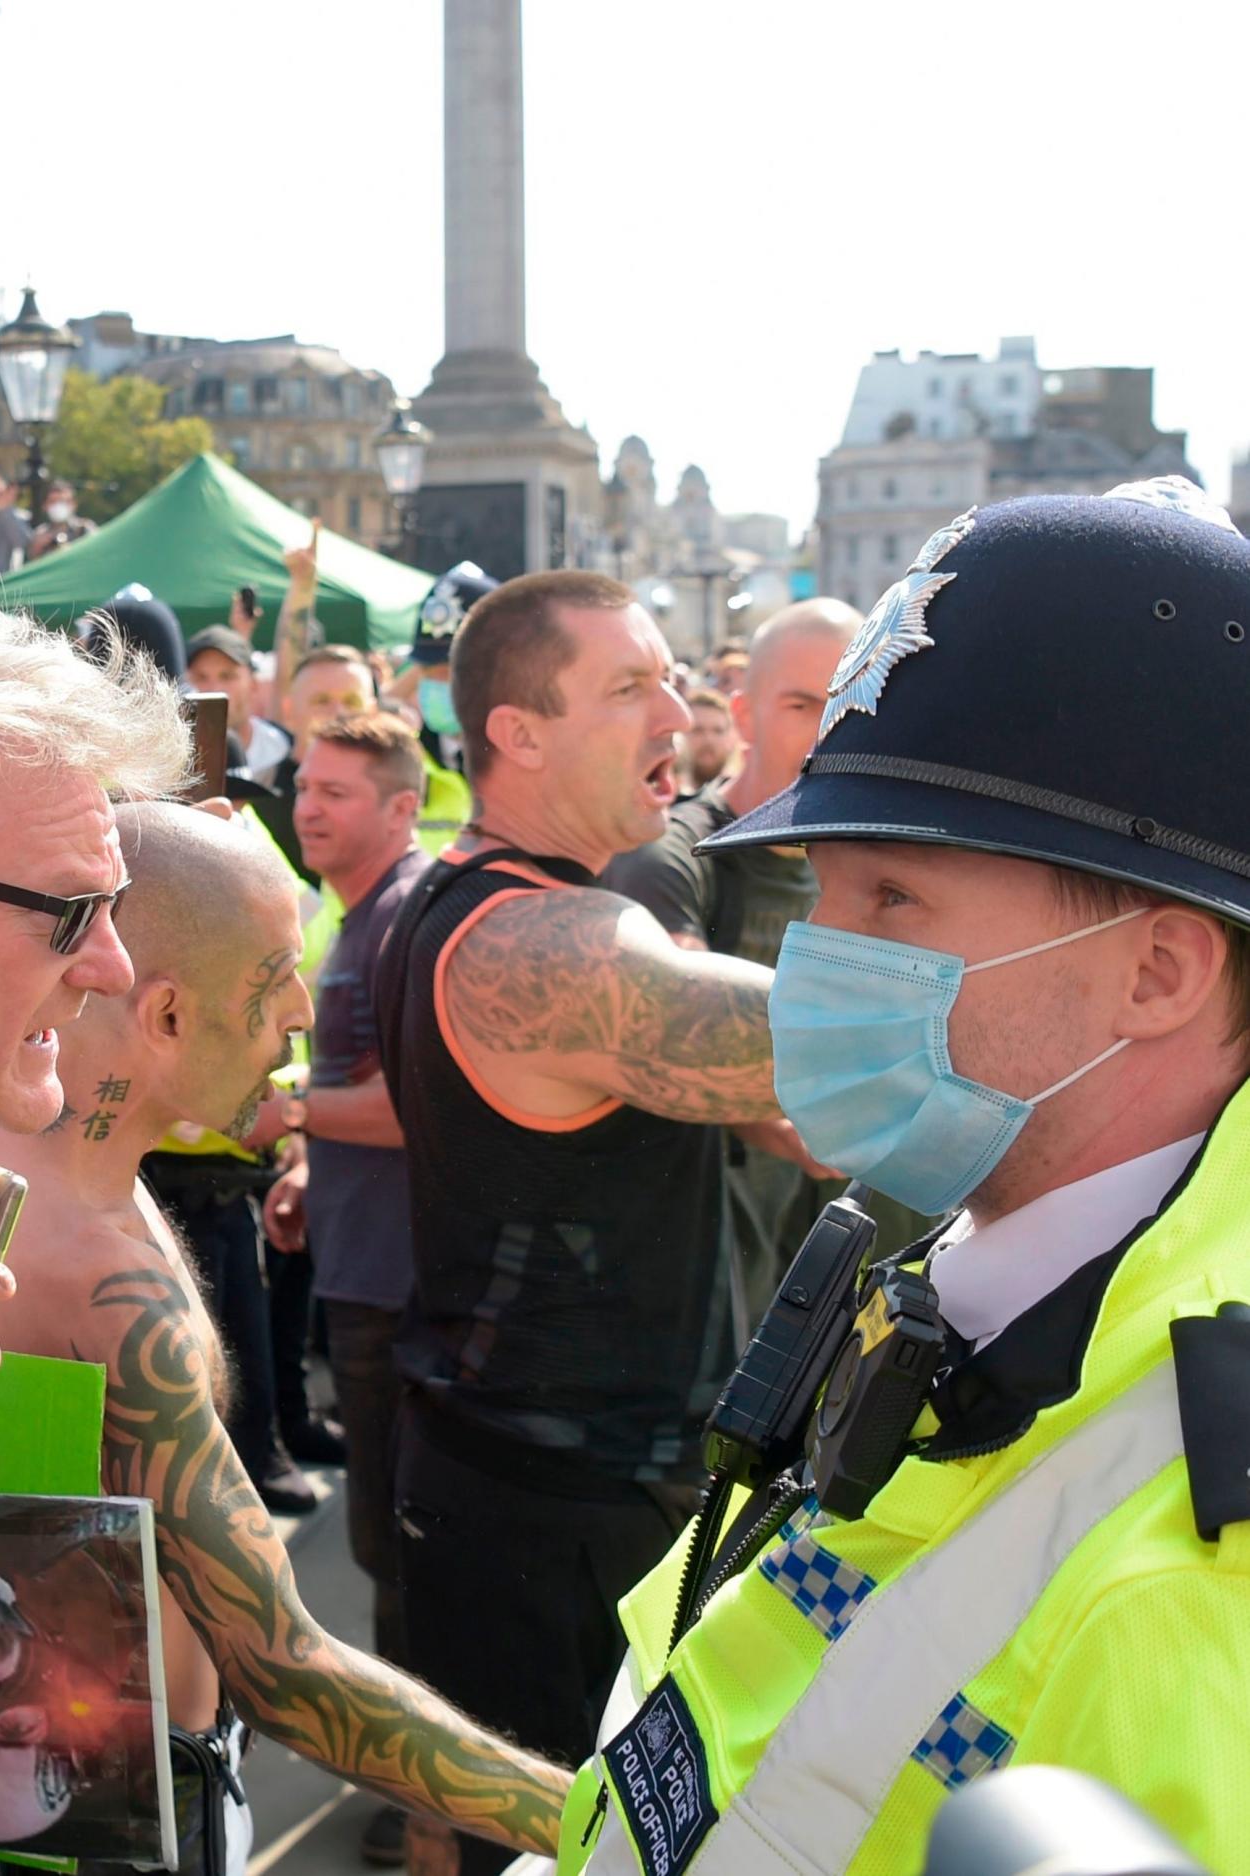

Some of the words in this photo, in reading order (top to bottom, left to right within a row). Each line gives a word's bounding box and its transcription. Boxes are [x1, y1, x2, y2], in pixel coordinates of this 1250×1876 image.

[81, 1074, 131, 1141] 相信
[616, 1740, 650, 1808] POLICE
[639, 1801, 670, 1876] OFFICER
[660, 1766, 688, 1832] POLICE
